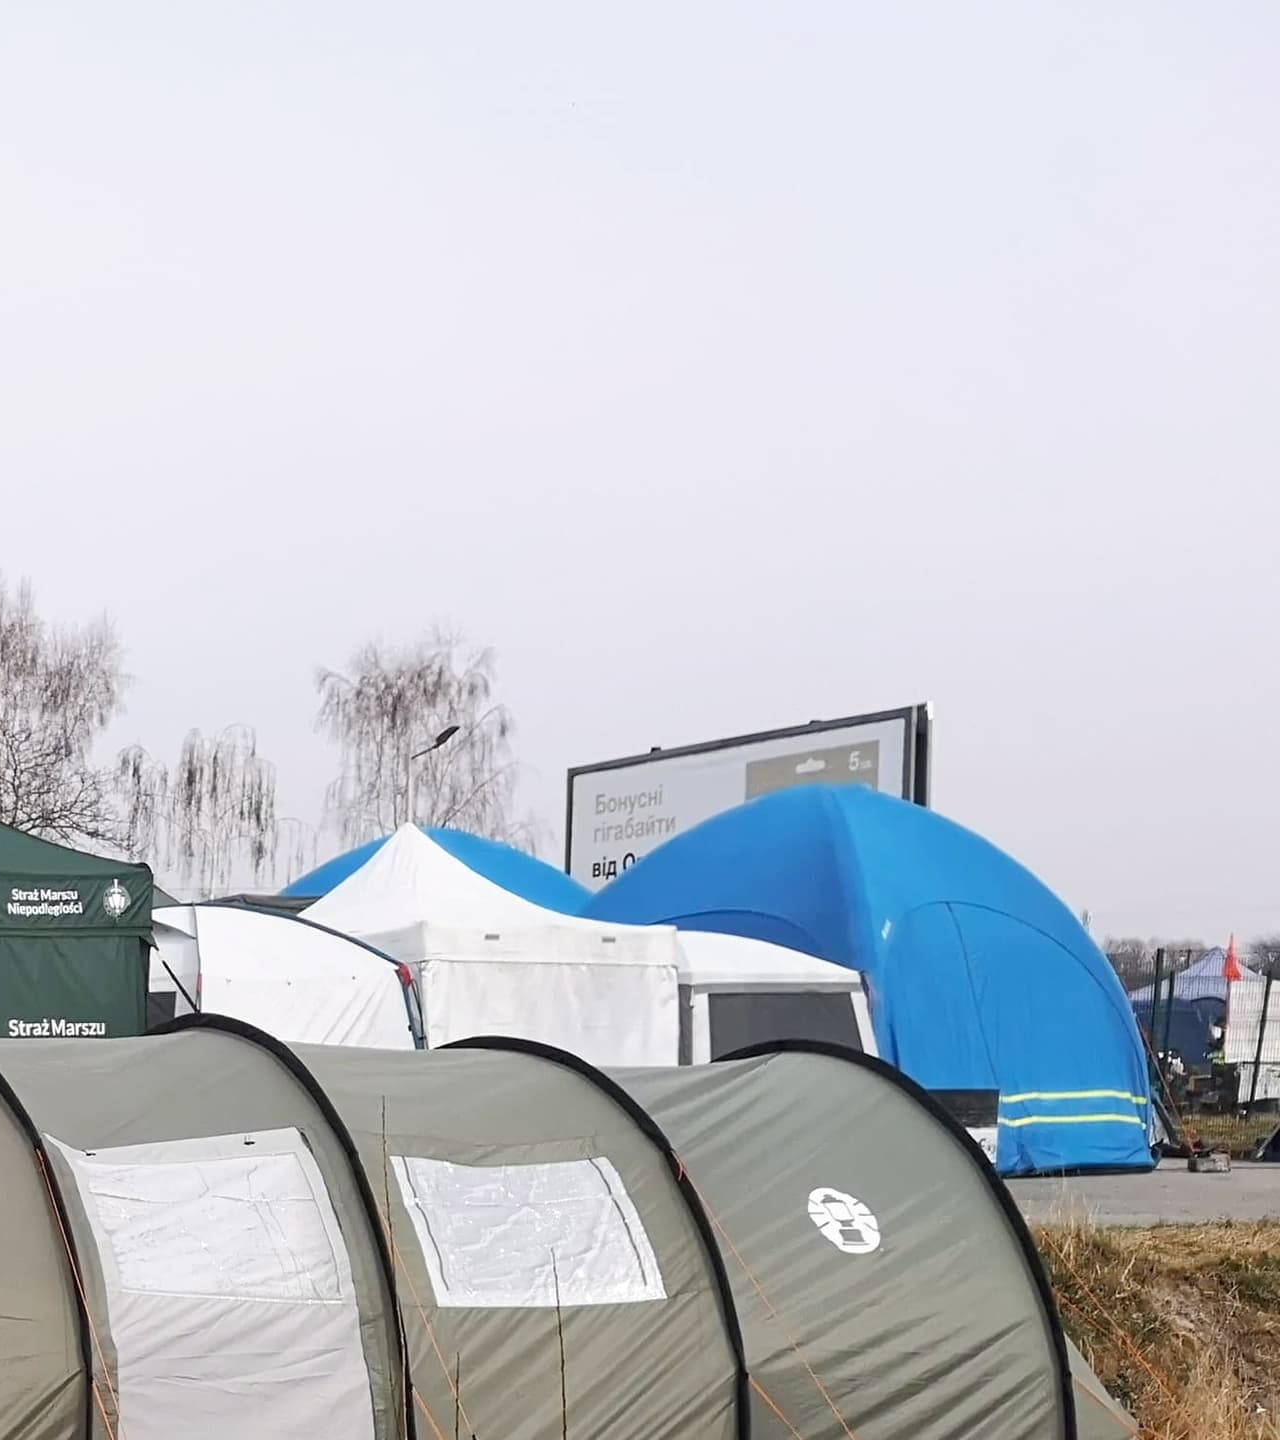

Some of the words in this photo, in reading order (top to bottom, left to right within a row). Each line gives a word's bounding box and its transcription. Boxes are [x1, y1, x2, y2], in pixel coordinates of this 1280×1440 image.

[594, 784, 664, 817] Бонусні
[593, 814, 677, 845] гігабайти
[592, 857, 617, 879] від
[11, 887, 39, 901] Straż
[40, 888, 78, 901] Marszu
[8, 1018, 51, 1037] Straż
[51, 1019, 106, 1036] Marszu
